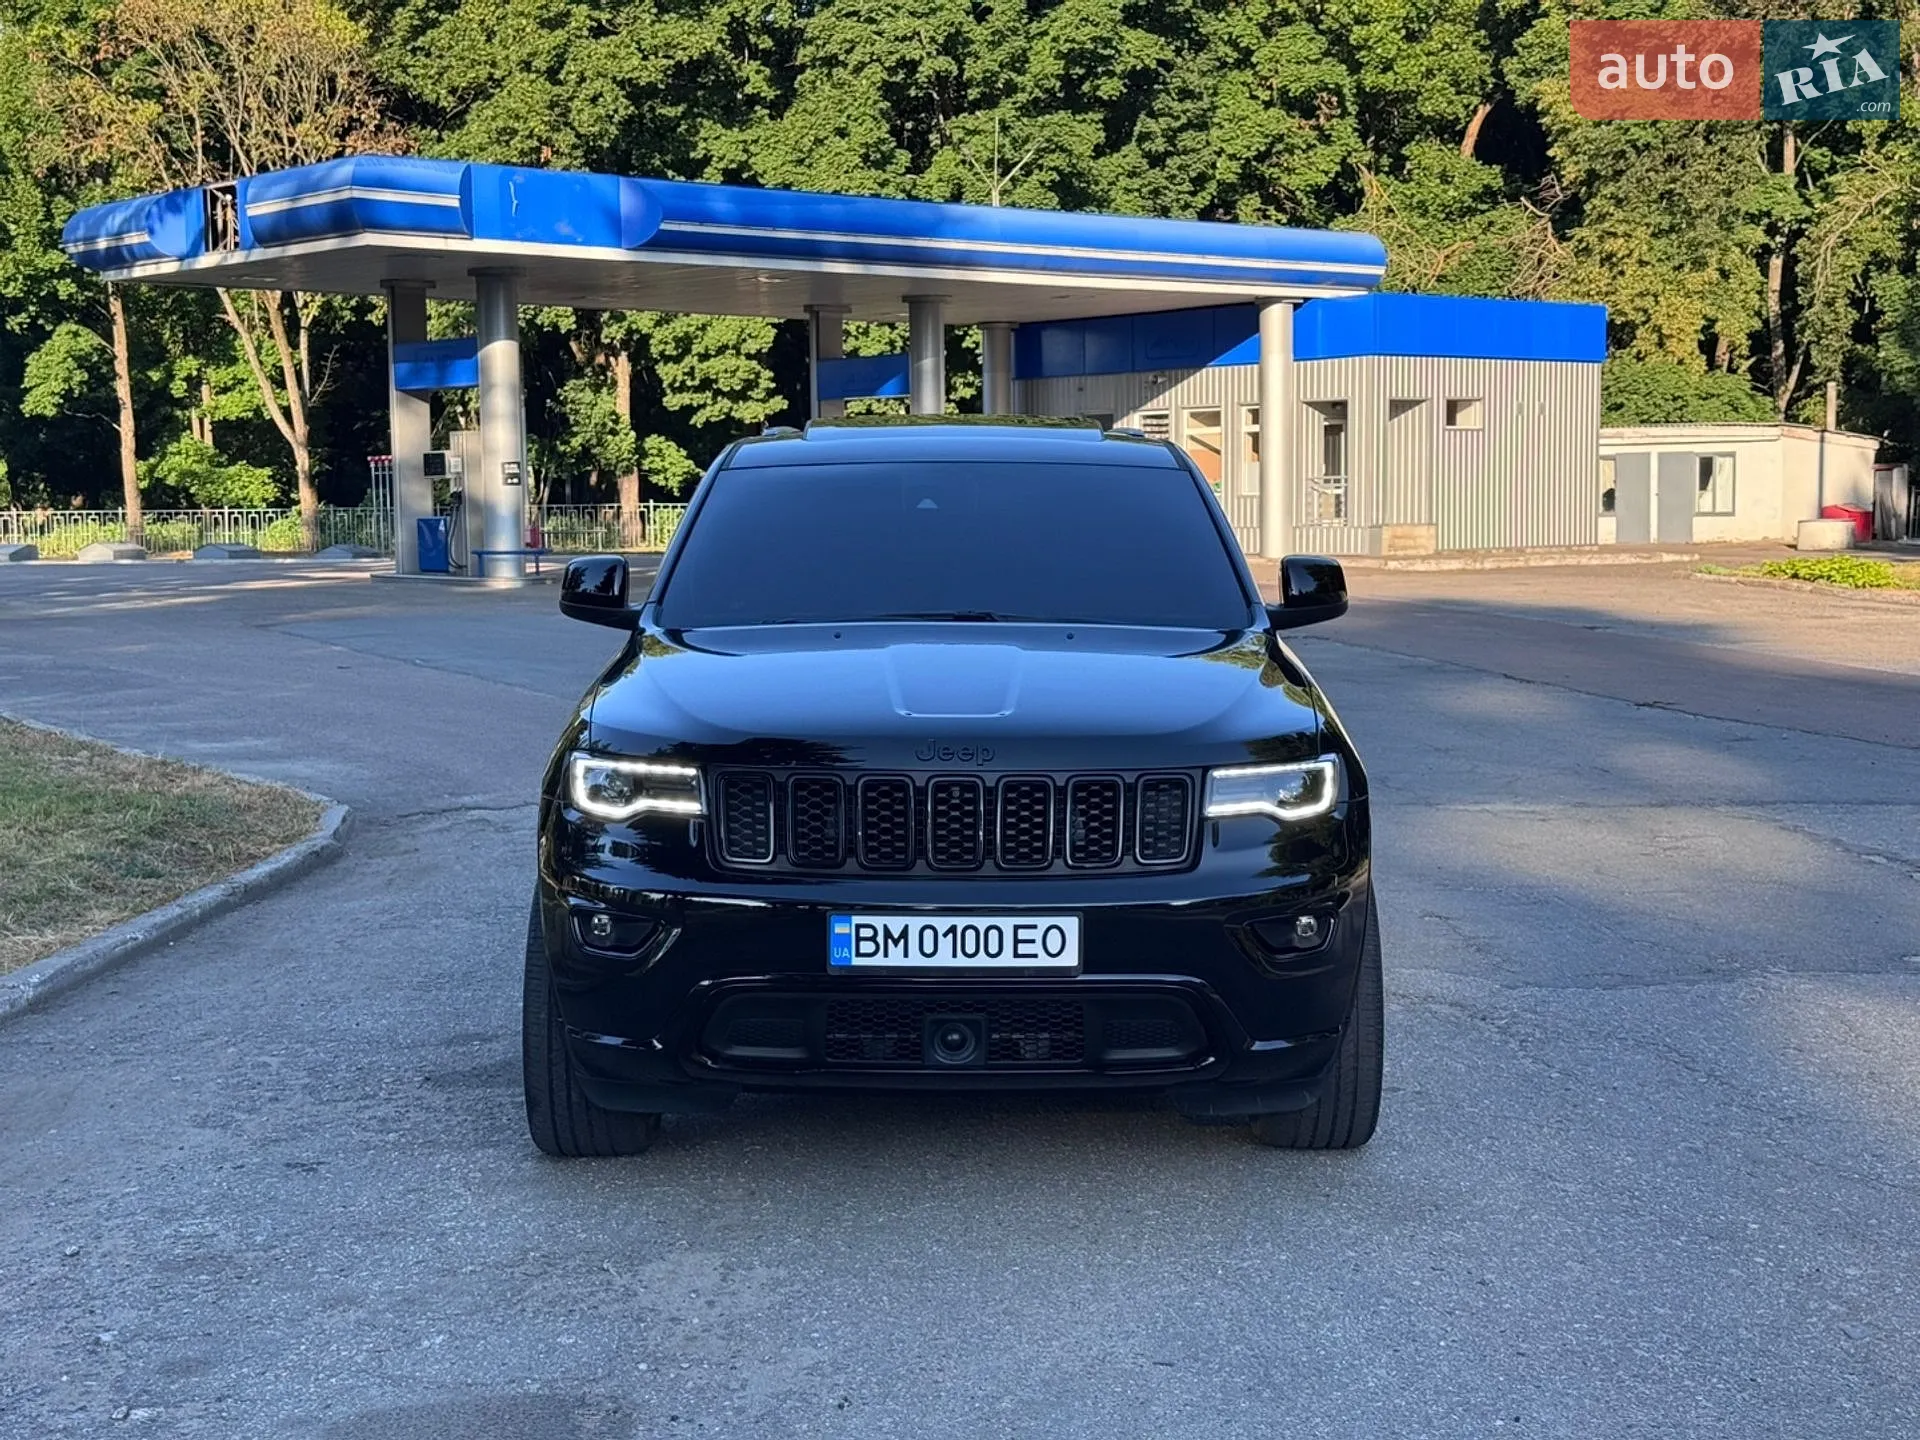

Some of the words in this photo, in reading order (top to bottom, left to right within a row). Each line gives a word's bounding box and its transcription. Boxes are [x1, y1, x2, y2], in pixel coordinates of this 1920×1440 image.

[914, 739, 995, 766] Jeep
[833, 947, 850, 958] UA
[854, 923, 909, 959] BM
[918, 923, 1004, 959] 0100
[1013, 923, 1067, 959] EO
